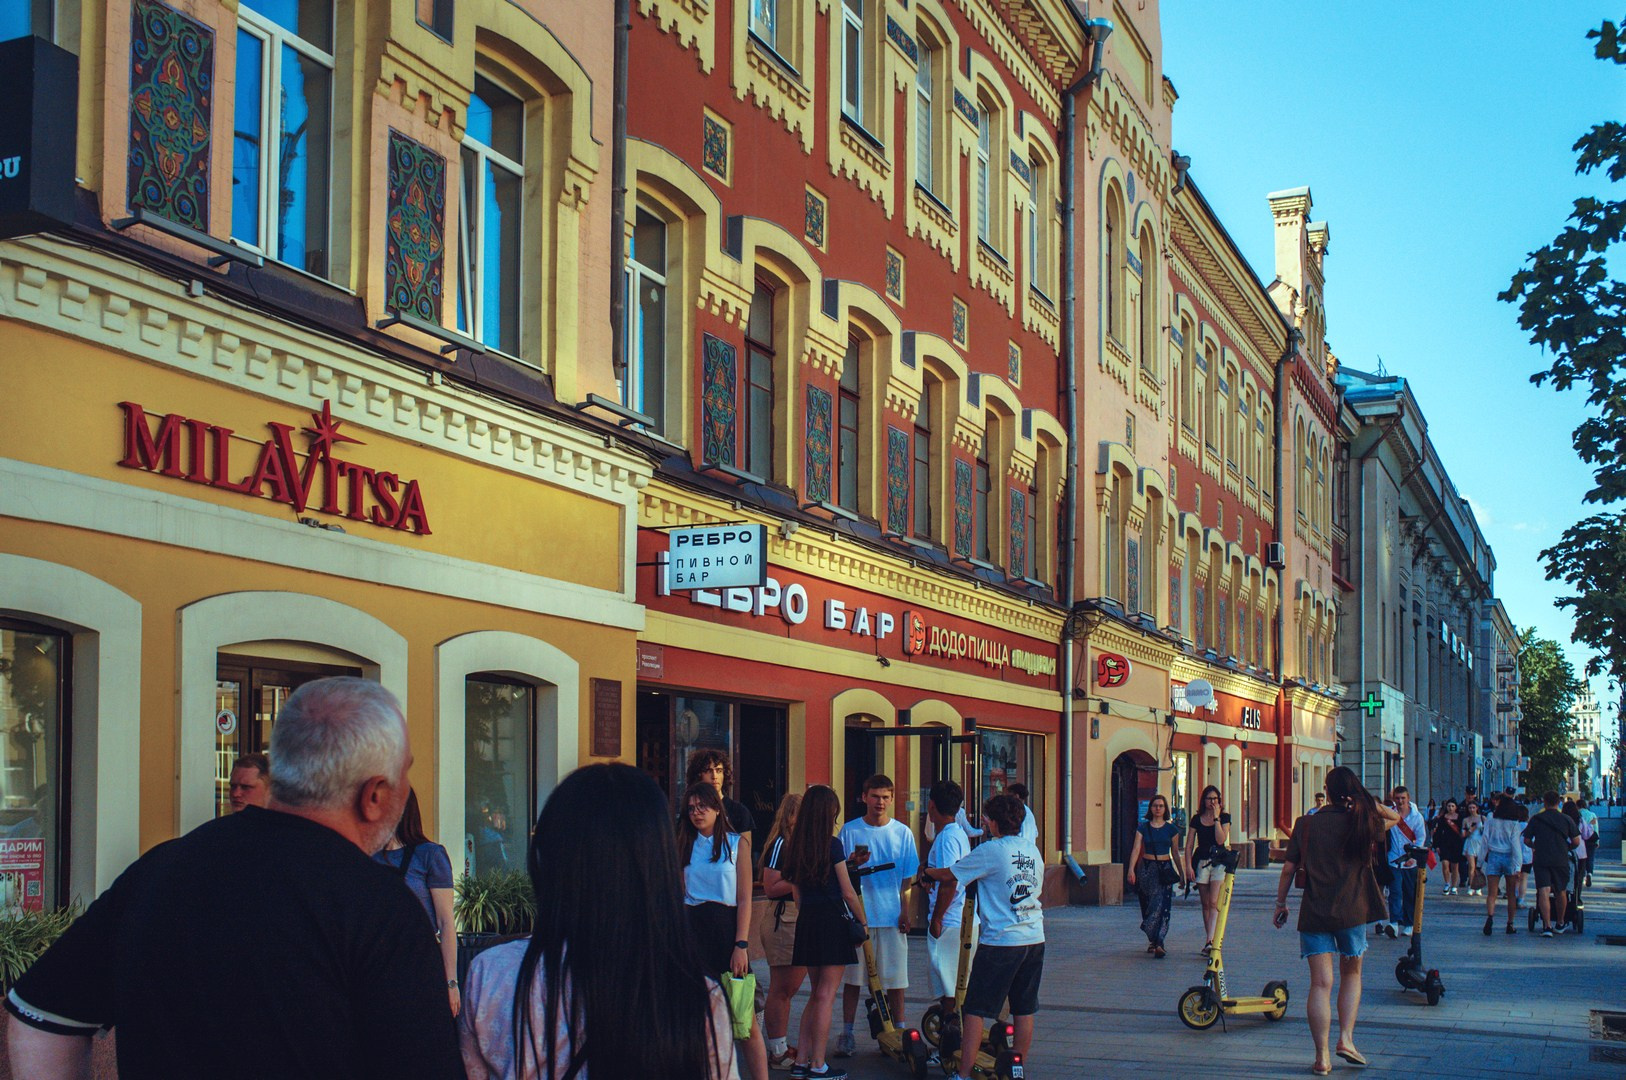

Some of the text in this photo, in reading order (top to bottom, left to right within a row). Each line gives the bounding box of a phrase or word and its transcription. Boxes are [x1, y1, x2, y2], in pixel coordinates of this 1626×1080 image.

[117, 400, 432, 535] MILAVITSA
[676, 531, 753, 547] РЕБРО
[676, 554, 753, 569] ПИВНОЙ
[676, 572, 709, 583] БАР
[825, 599, 895, 639] БАР
[1243, 706, 1261, 730] ELIS
